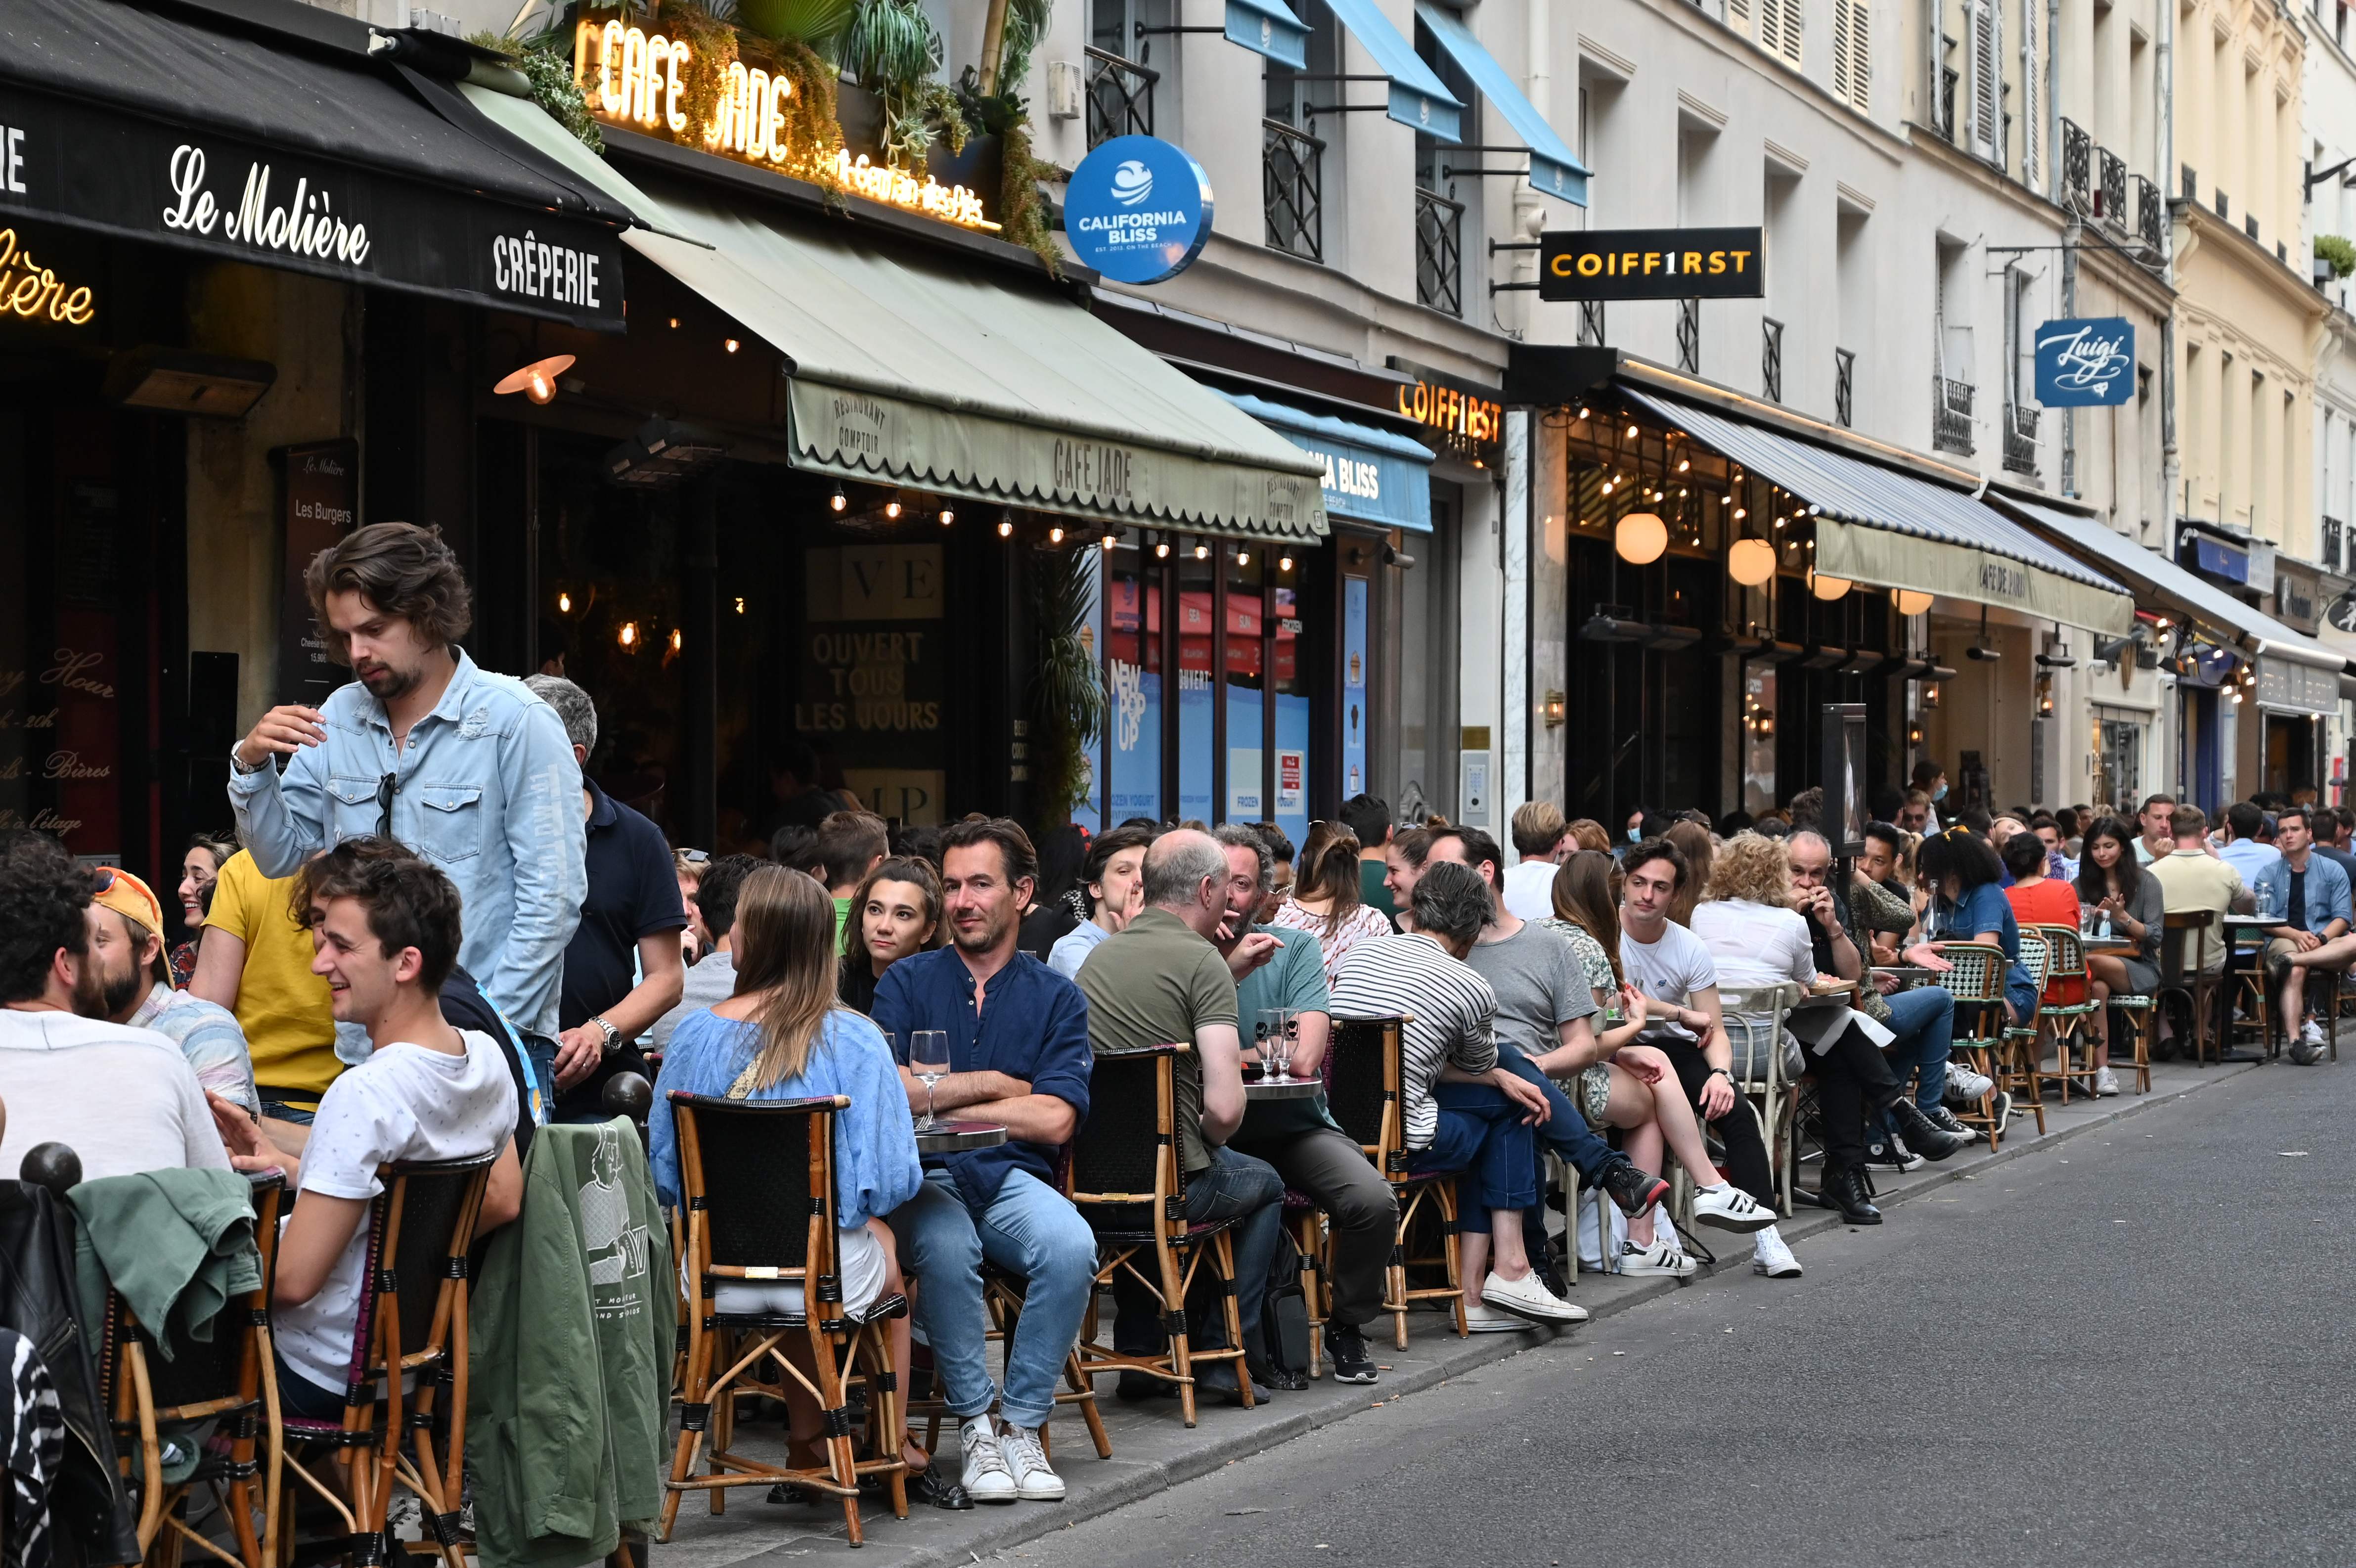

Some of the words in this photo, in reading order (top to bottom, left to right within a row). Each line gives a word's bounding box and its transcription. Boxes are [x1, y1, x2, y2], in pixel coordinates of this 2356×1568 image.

[600, 19, 689, 133] CAFE
[703, 61, 791, 164] JADE
[164, 144, 219, 234] Le
[225, 162, 370, 266] Molière
[1079, 210, 1187, 230] CALIFORNIA
[1109, 227, 1157, 244] BLISS
[493, 230, 600, 309] CRÊPERIE
[1550, 250, 1752, 278] COIFF1RST
[2039, 325, 2129, 391] Luigi
[834, 395, 886, 430] RESTAURANT
[1399, 379, 1502, 443] COIFF1RST
[839, 426, 879, 455] COMPTOIR
[1448, 433, 1478, 457] PARIS
[1054, 437, 1092, 493] CAFE
[1097, 447, 1132, 498] JADE
[1338, 457, 1379, 500] BLISS
[296, 499, 312, 518] Les
[315, 501, 352, 526] Burgers
[812, 632, 924, 664] OUVERT
[39, 648, 115, 698] Hour
[829, 667, 904, 697] TOUS
[1111, 658, 1141, 695] NEW
[795, 703, 846, 731] LES
[855, 701, 942, 731] JOURS
[1119, 692, 1146, 723] POP
[42, 750, 111, 779] Bières
